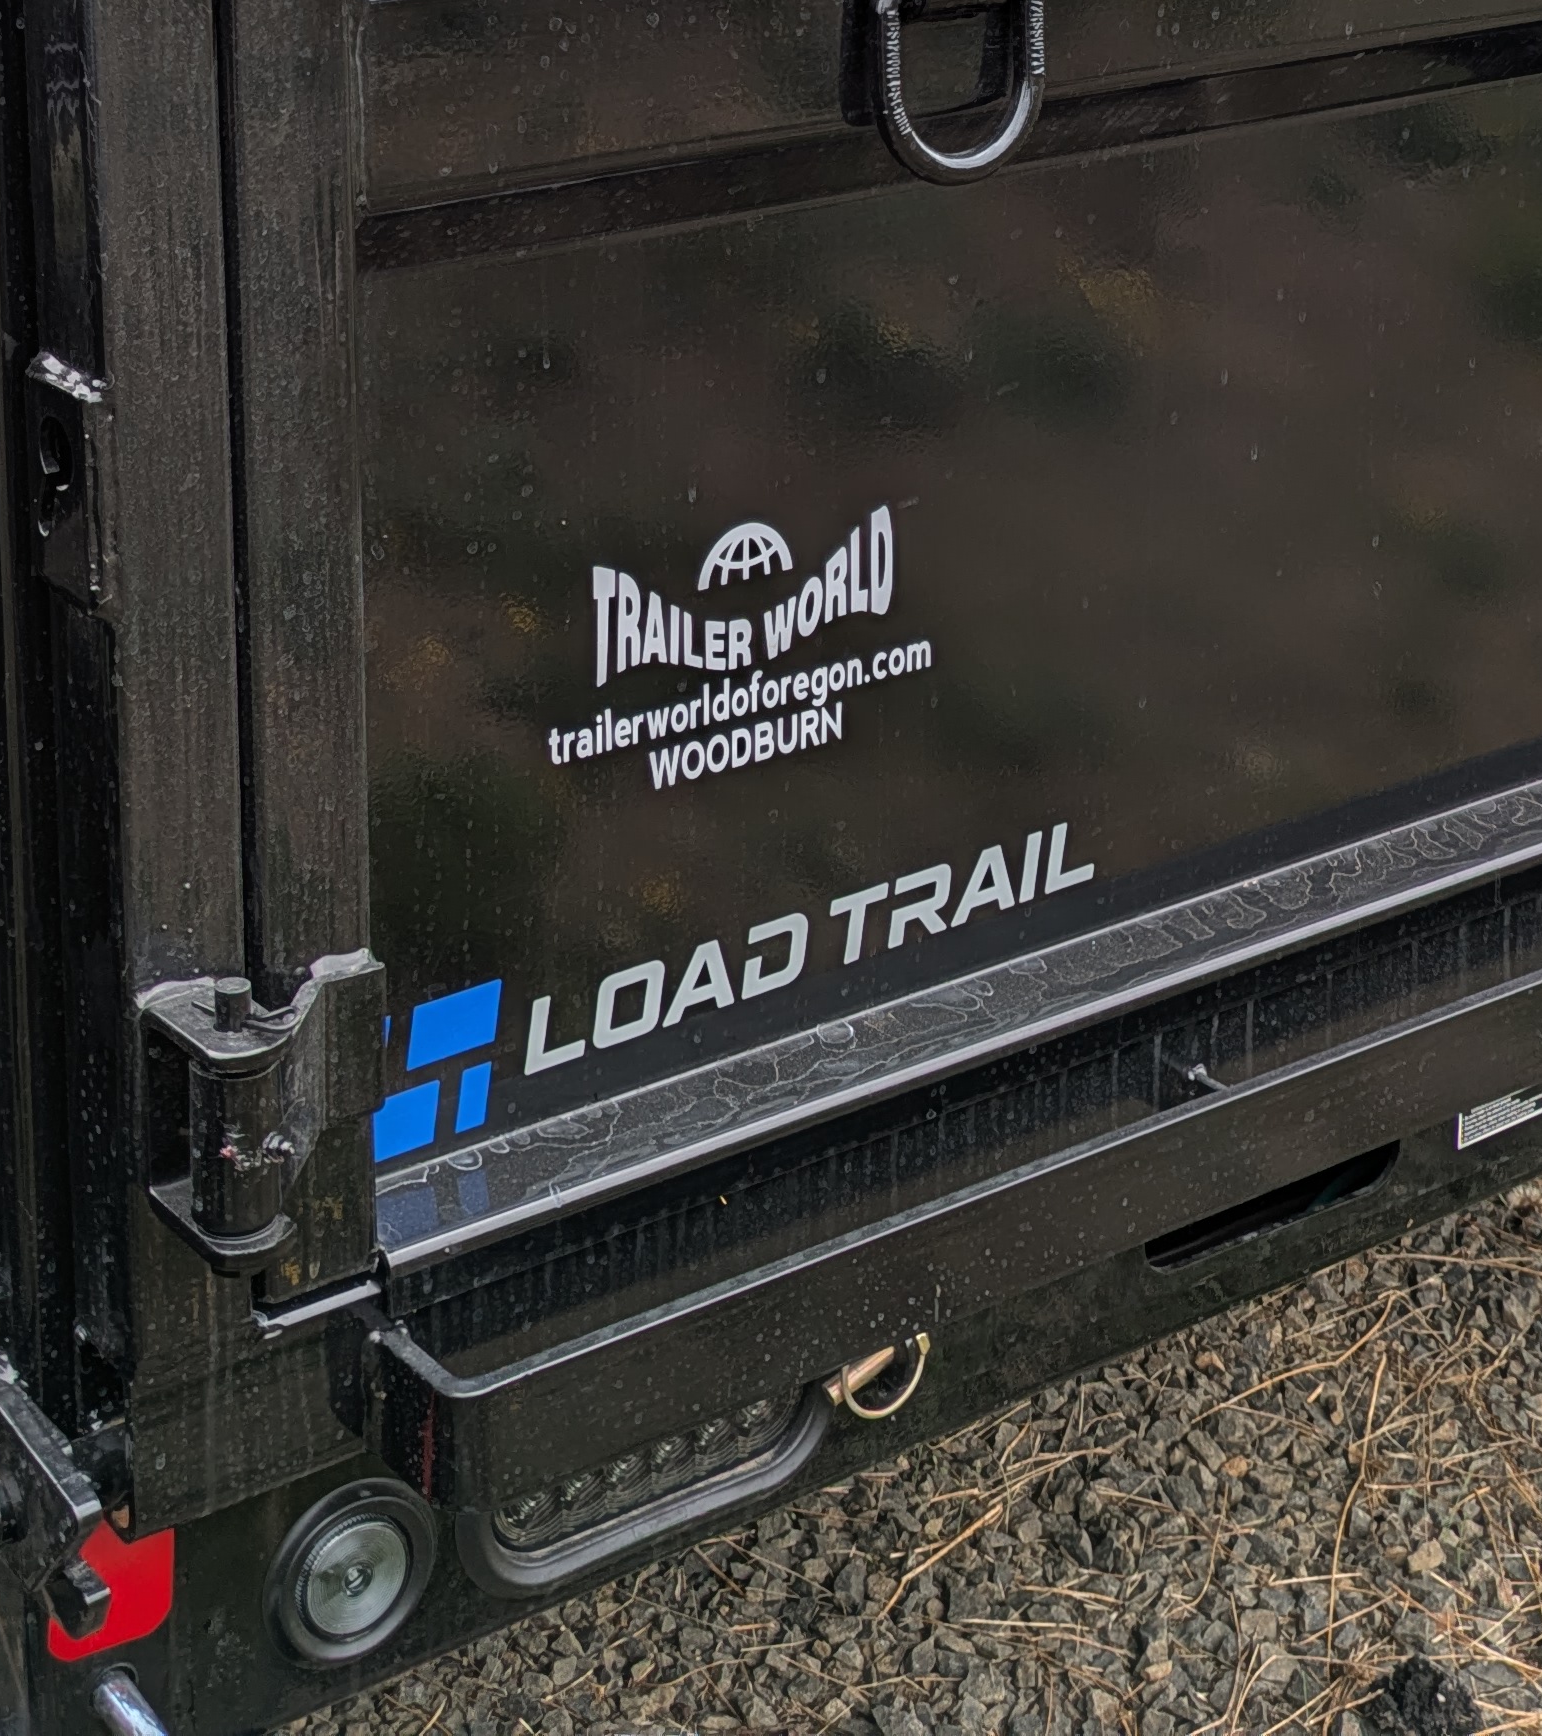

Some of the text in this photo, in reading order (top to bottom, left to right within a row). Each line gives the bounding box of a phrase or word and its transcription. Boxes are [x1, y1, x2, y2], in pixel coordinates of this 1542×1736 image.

[592, 505, 894, 688] TRAILER WORLD
[548, 640, 932, 765] trailerworldoforegon.com
[648, 702, 843, 790] WOODBURN
[523, 822, 1096, 1076] LOAD TRAIL
